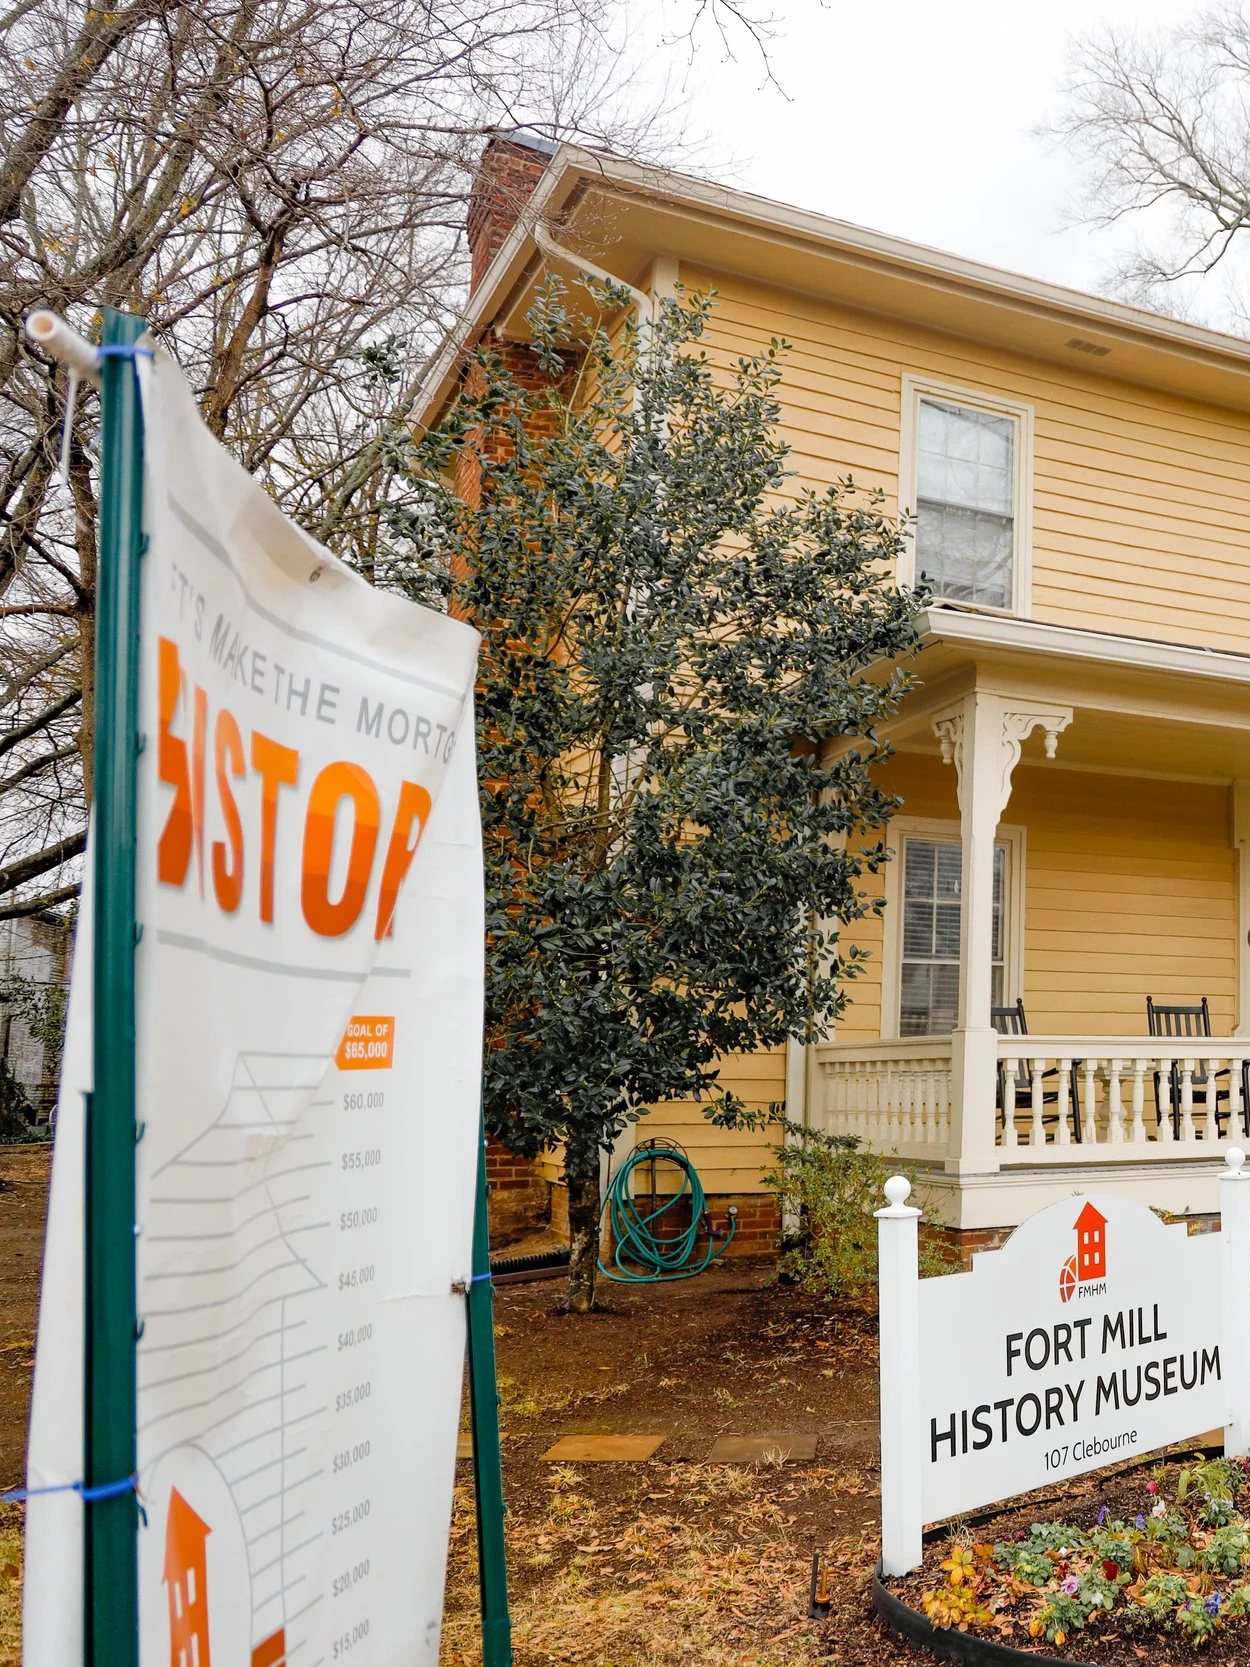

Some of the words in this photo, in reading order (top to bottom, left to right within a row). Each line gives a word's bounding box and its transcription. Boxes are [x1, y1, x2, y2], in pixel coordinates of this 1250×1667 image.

[209, 613, 266, 696] MAKE
[273, 663, 341, 725] THE
[346, 1023, 373, 1037] GOAL
[375, 1023, 389, 1037] OF
[345, 1041, 388, 1061] $65,000
[343, 1092, 385, 1112] $60,000
[341, 1149, 382, 1172] $55,000
[339, 1207, 377, 1232] $50,000
[338, 1266, 375, 1292] $45,000
[1078, 1282, 1107, 1299] FMHM
[337, 1323, 372, 1352] $40,000
[1006, 1318, 1092, 1377] FORT
[1101, 1303, 1167, 1354] MILL
[335, 1381, 371, 1413] $35,000
[930, 1380, 1085, 1463] HISTORY
[1094, 1345, 1222, 1416] MUSEUM
[332, 1440, 370, 1475] $30,000
[1043, 1446, 1069, 1471] 107
[1072, 1428, 1138, 1462] Clebourne
[331, 1499, 370, 1536] $25,000
[332, 1558, 370, 1598] $20,000
[332, 1618, 369, 1661] $15,000
